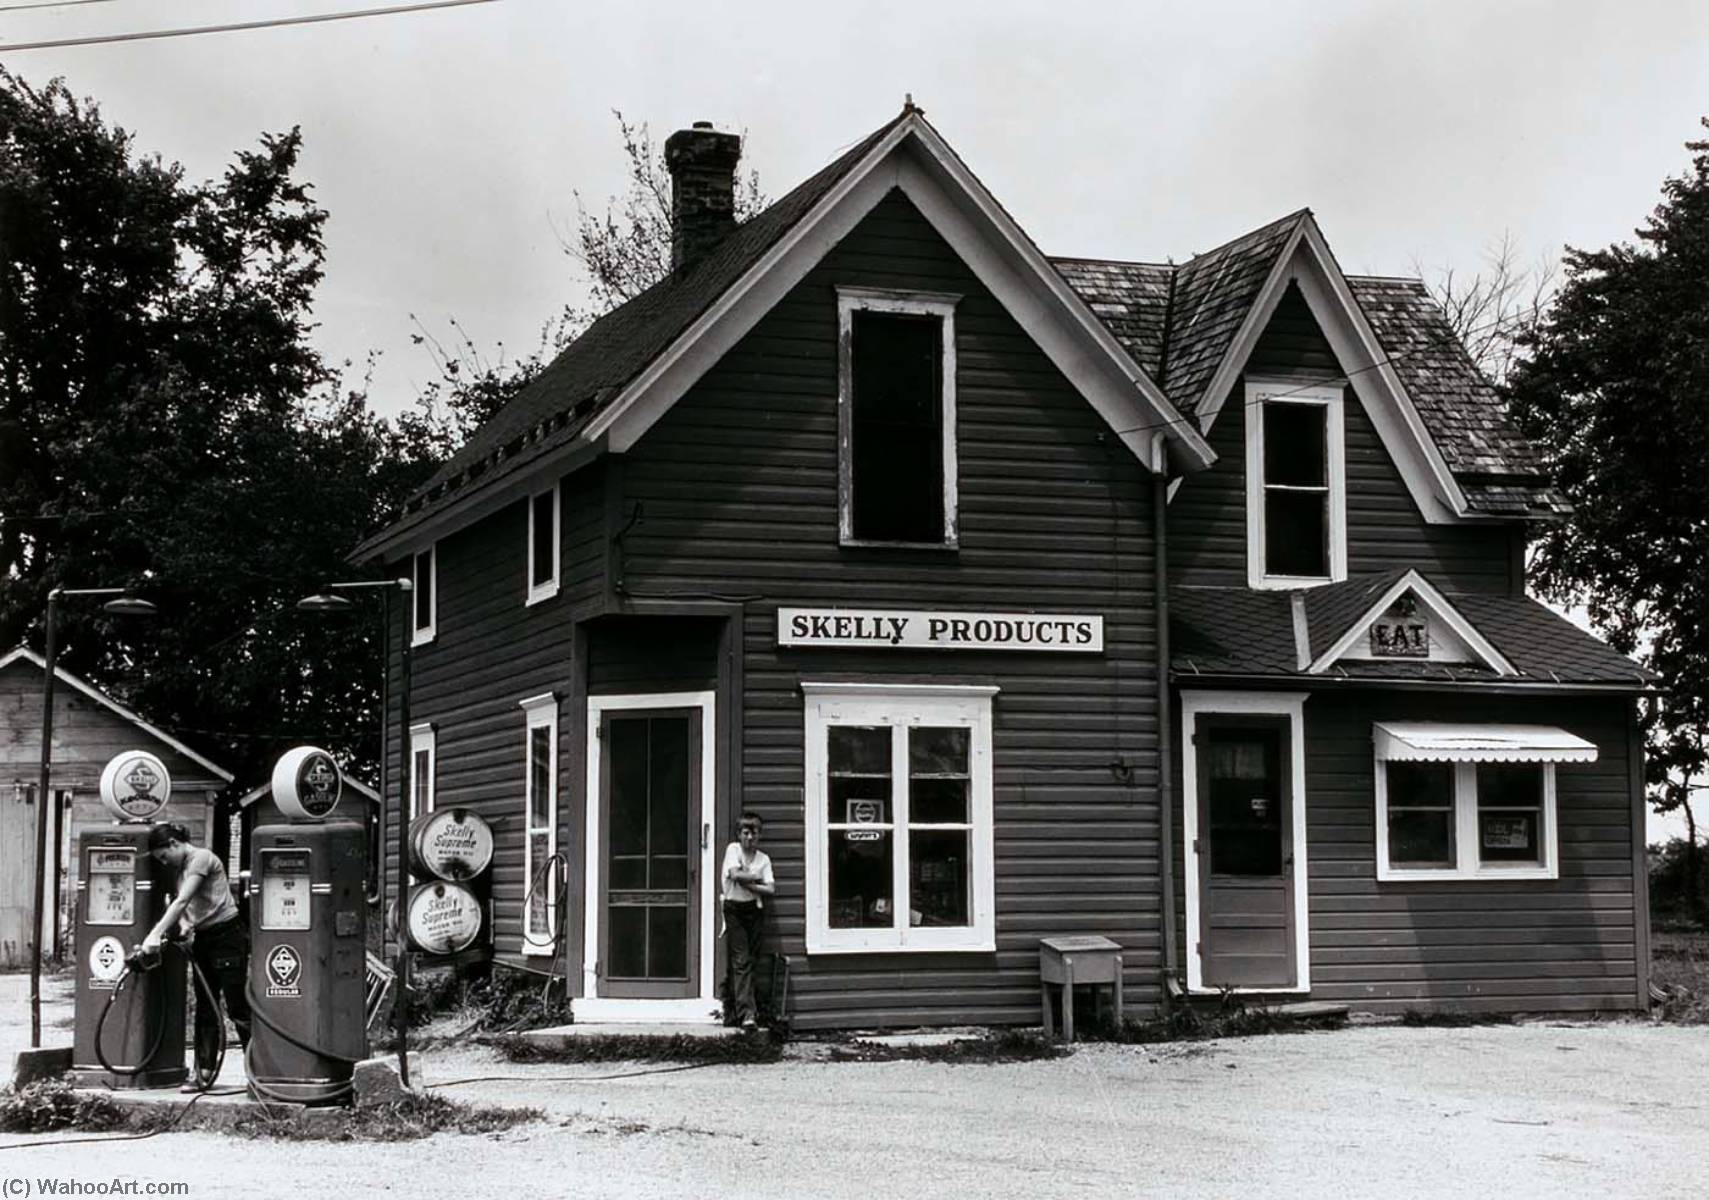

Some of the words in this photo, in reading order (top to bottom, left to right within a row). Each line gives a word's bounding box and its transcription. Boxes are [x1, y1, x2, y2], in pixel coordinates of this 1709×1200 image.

[792, 615, 909, 645] SKELLY
[928, 618, 1093, 644] PRODUCTS
[1376, 624, 1425, 648] EAT
[443, 824, 476, 841] Skelly
[434, 834, 477, 849] Supreme
[428, 895, 459, 912] Skelly
[422, 907, 463, 925] Supreme
